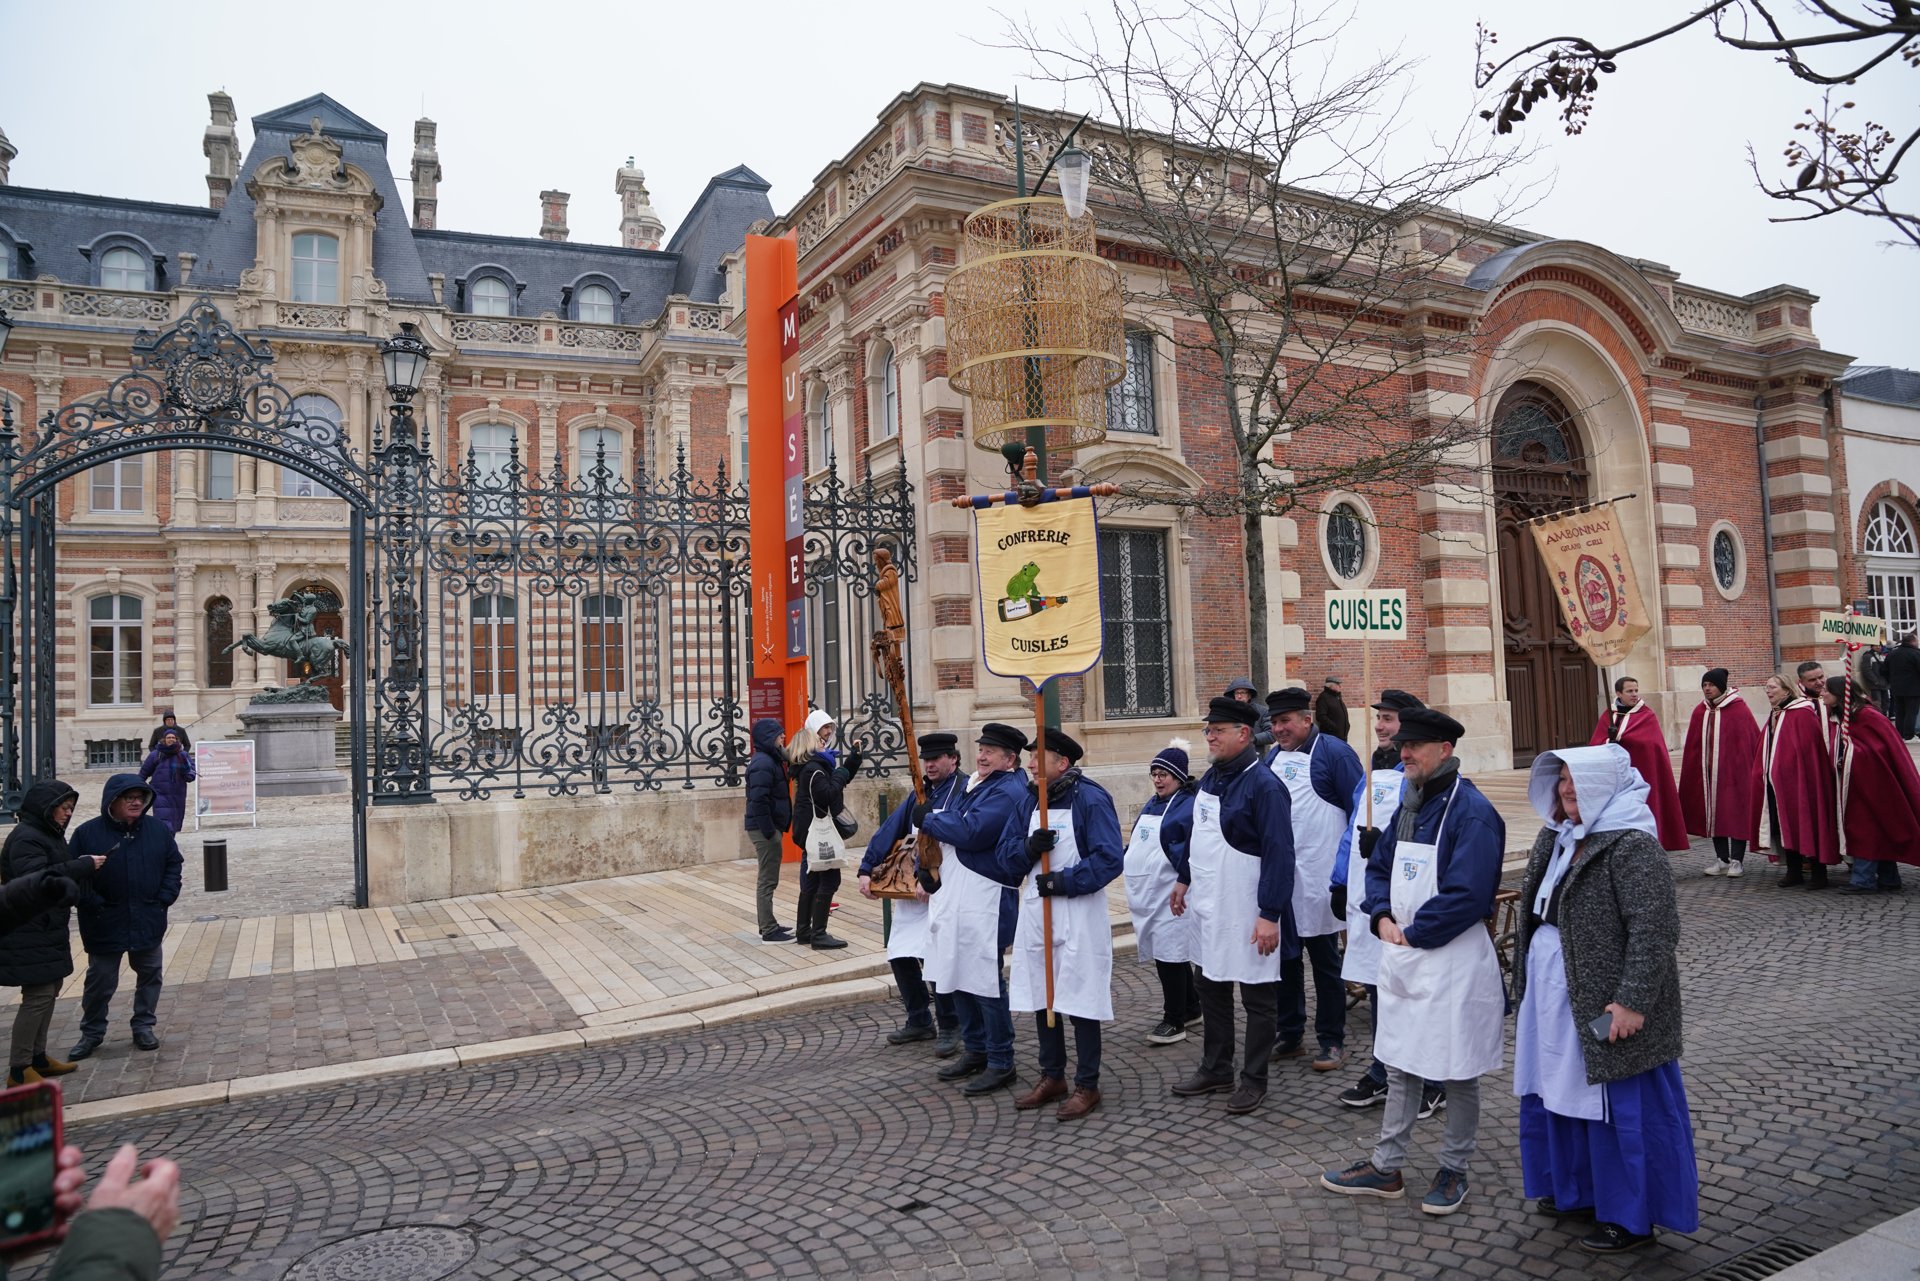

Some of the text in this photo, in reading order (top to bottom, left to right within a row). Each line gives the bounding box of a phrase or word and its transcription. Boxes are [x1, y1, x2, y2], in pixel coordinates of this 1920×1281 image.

[783, 312, 799, 585] MUSÉE
[998, 529, 1070, 551] CONFRERIE
[1546, 521, 1611, 545] AMBONNAY
[1586, 538, 1603, 547] CRU
[1329, 598, 1402, 630] CUISLES
[1822, 619, 1878, 637] AMBONNAY
[1011, 634, 1069, 653] CUISLES
